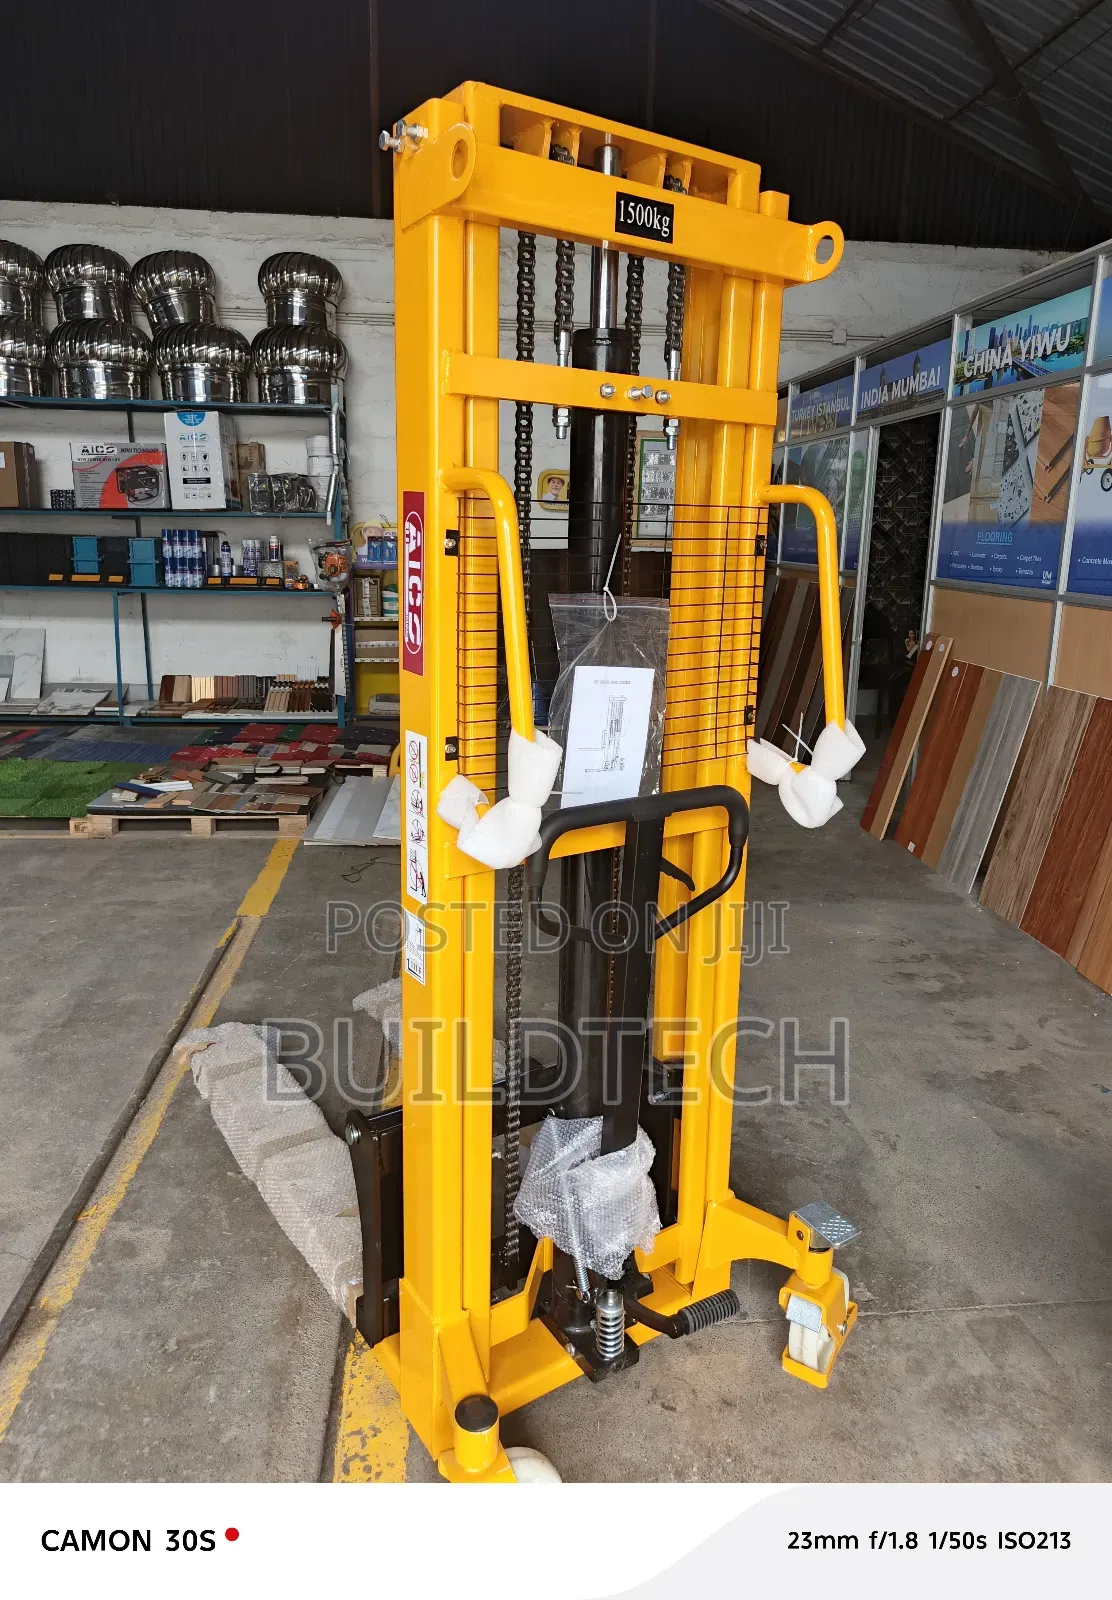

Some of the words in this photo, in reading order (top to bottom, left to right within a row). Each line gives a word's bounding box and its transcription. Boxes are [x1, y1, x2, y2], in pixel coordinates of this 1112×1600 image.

[619, 199, 671, 238] 1500kg
[963, 343, 1014, 379] CHINA
[1019, 323, 1072, 363] YIWU
[860, 387, 890, 410] INDIA
[891, 365, 941, 400] MUMBAI
[791, 405, 817, 423] TURKEY
[816, 395, 851, 418] ISTANBUL
[81, 445, 116, 454] AICS
[976, 531, 1014, 543] FLOORING
[1081, 556, 1102, 565] Concrete
[408, 522, 422, 646] AICS
